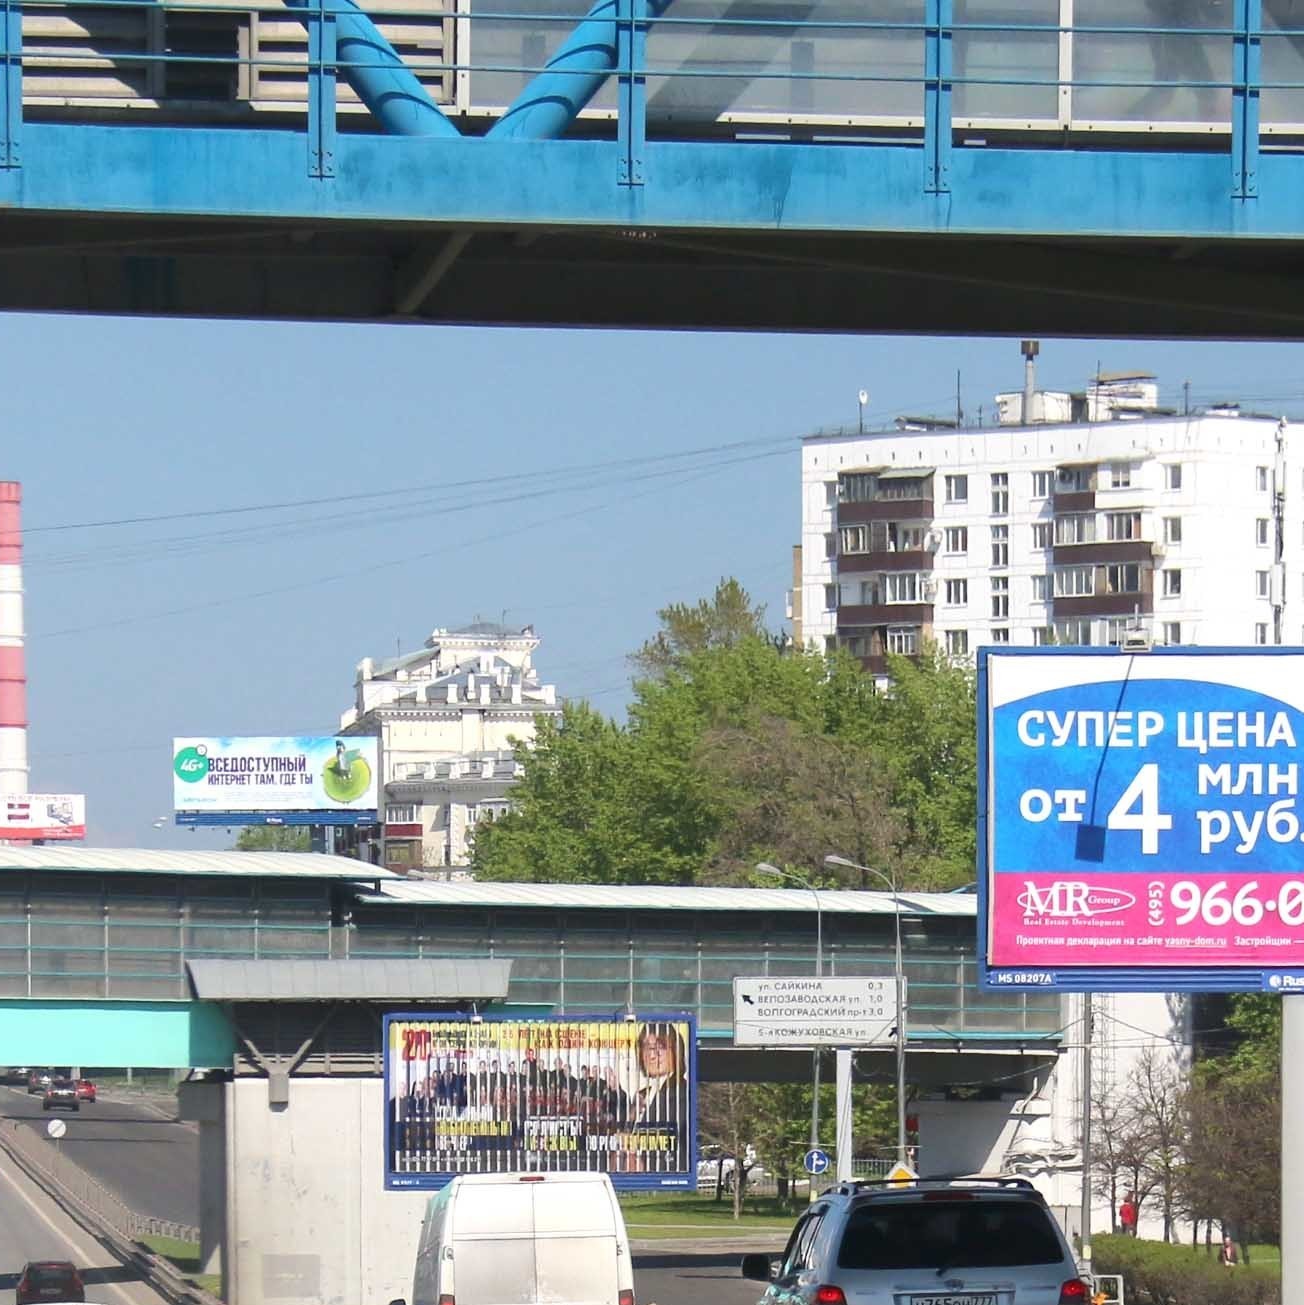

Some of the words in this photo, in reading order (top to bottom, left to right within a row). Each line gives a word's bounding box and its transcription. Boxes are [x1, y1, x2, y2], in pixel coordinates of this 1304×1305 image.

[1017, 709, 1164, 748] СУПЕР
[1177, 711, 1296, 754] ЦЕНА
[207, 754, 306, 772] ВСЕДОСТУПНЫЙ
[207, 773, 251, 786] ИНТЕРНЕТ
[1107, 763, 1173, 854] 4
[1023, 881, 1094, 917] MR
[1087, 894, 1121, 908] Group
[1147, 881, 1166, 926] (495)
[774, 980, 823, 990] САЙКИНА
[997, 974, 1013, 984] MS
[758, 1006, 846, 1017] ВОЛГОГРАДСКИЙ
